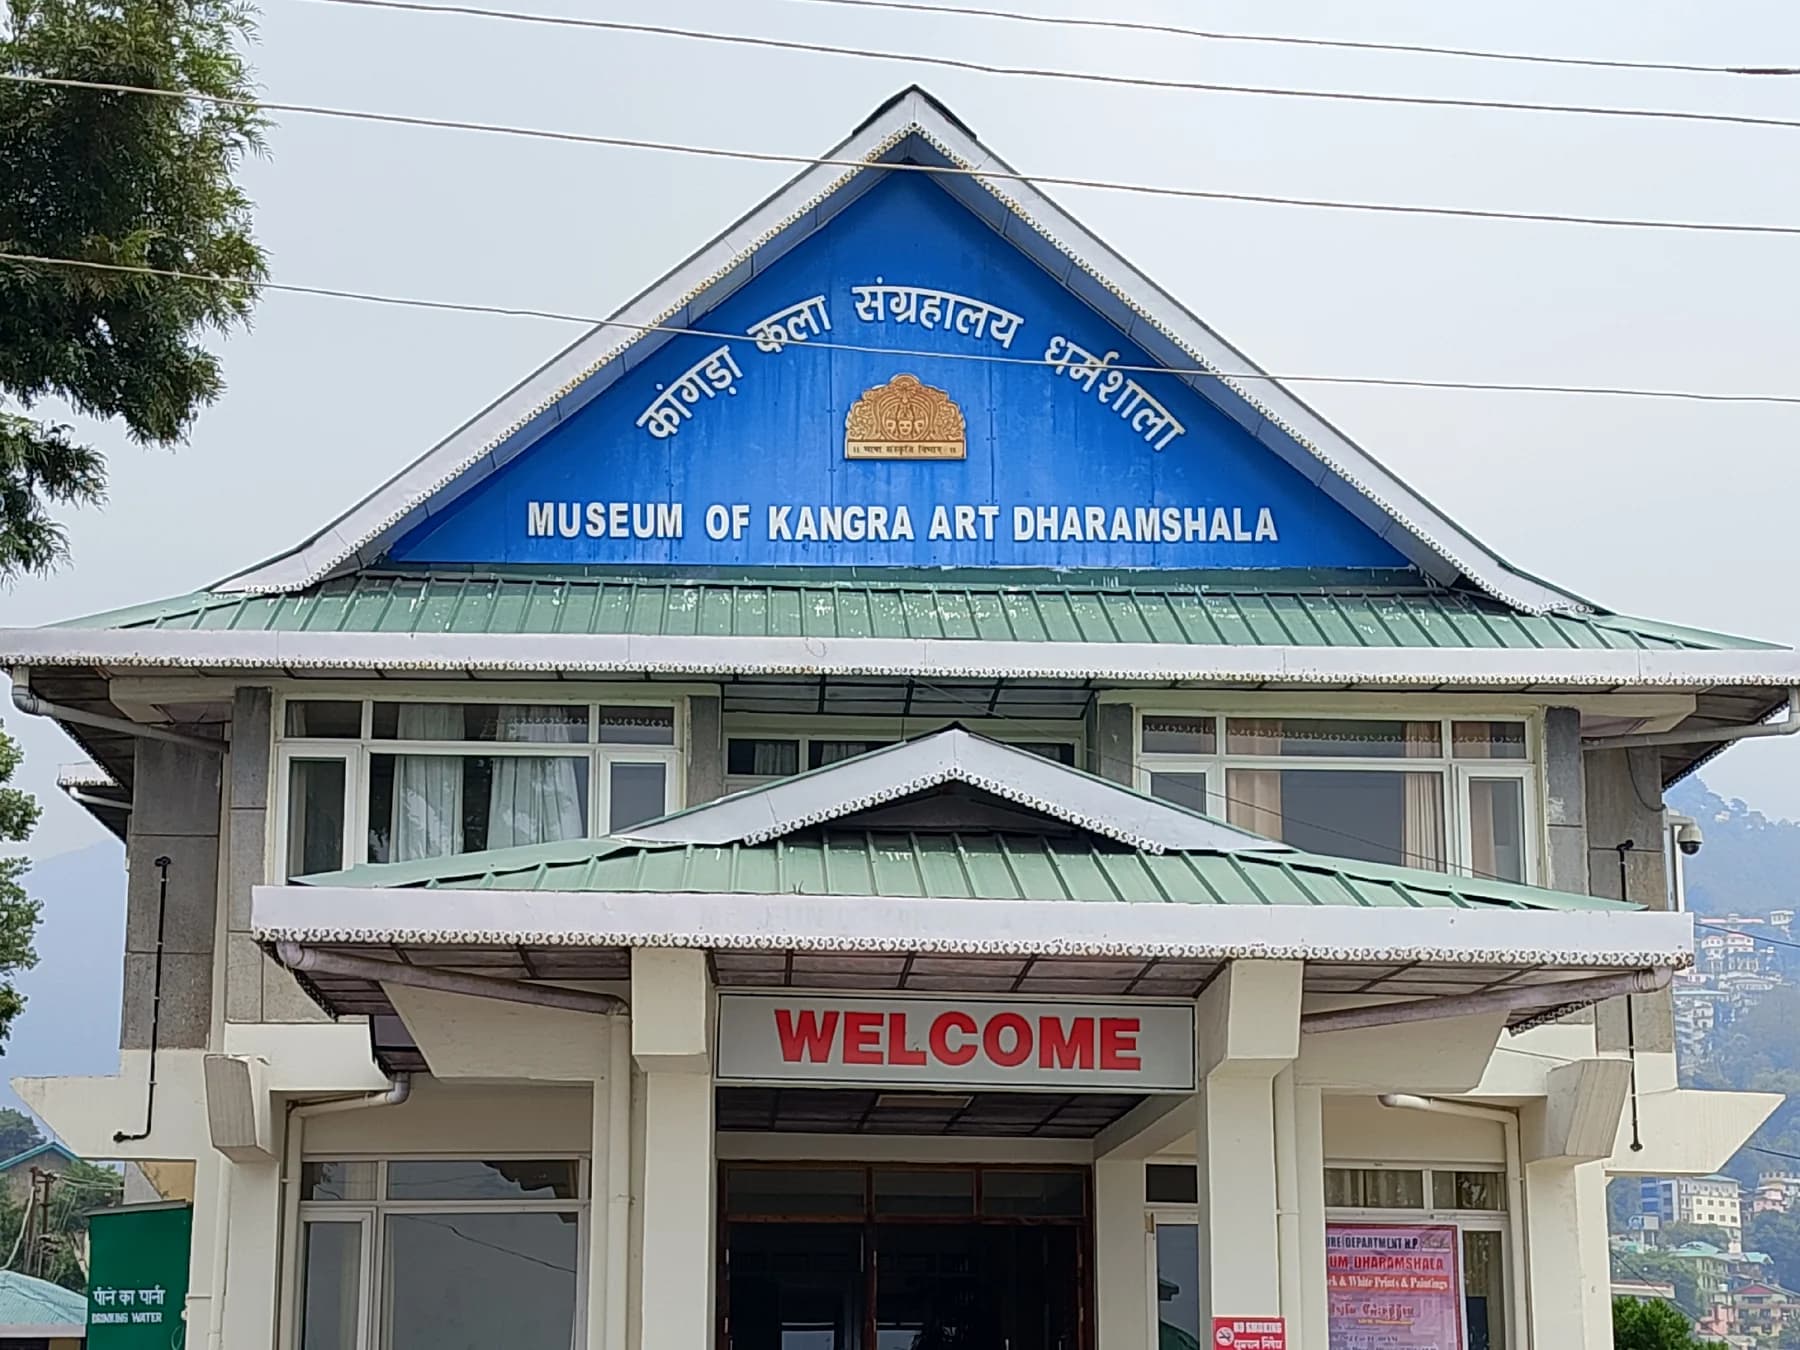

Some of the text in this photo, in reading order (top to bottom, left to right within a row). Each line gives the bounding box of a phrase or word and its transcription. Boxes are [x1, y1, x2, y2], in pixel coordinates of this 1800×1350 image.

[636, 276, 1188, 453] कांगड़ा कला संग्रहालय धर्मशाला
[527, 501, 1278, 543] MUSEUM OF KANGRA ART DHARAMSHALA
[775, 1009, 1141, 1070] WELCOME
[1345, 1237, 1403, 1250] DEPARTMENT
[1354, 1256, 1444, 1271] DHARAMSHALA
[1349, 1276, 1373, 1288] White
[131, 1311, 163, 1324] WATER
